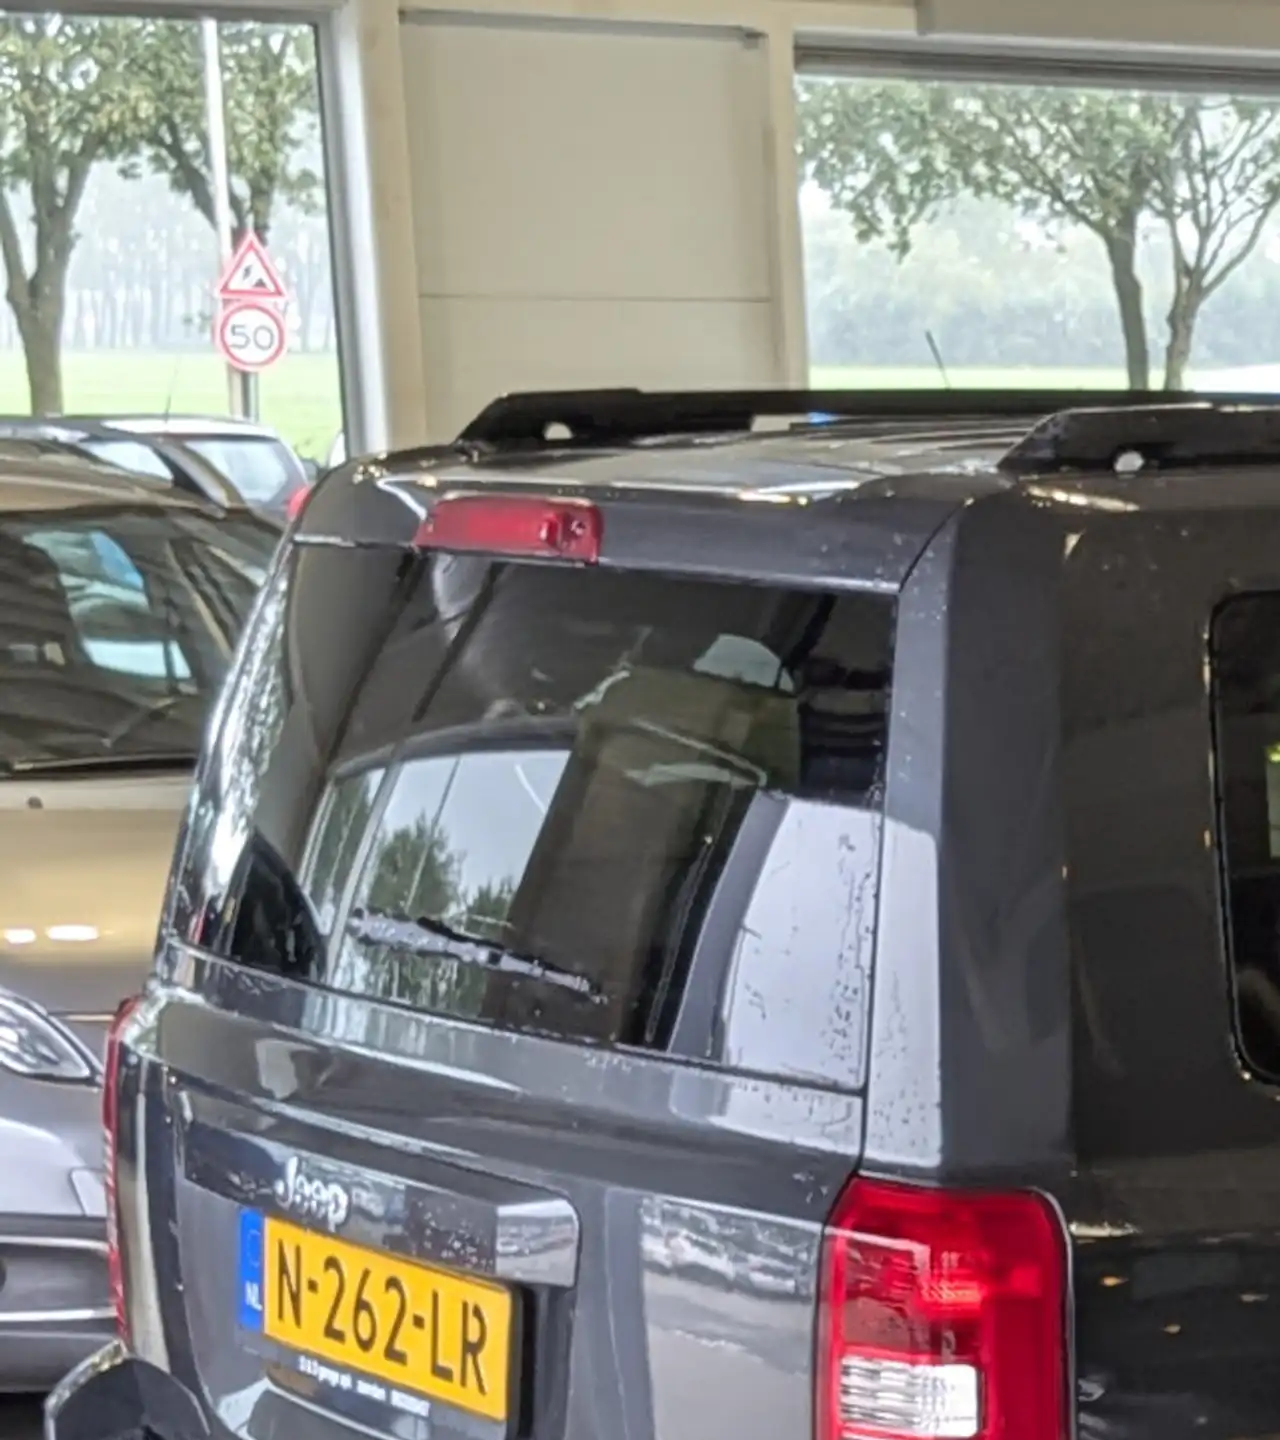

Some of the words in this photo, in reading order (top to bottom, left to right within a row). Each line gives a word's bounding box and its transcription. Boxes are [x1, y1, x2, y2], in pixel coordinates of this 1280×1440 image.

[229, 323, 275, 351] 50
[274, 1156, 349, 1233] Jeep
[245, 1280, 264, 1312] NL
[277, 1238, 487, 1397] N-262-LR
